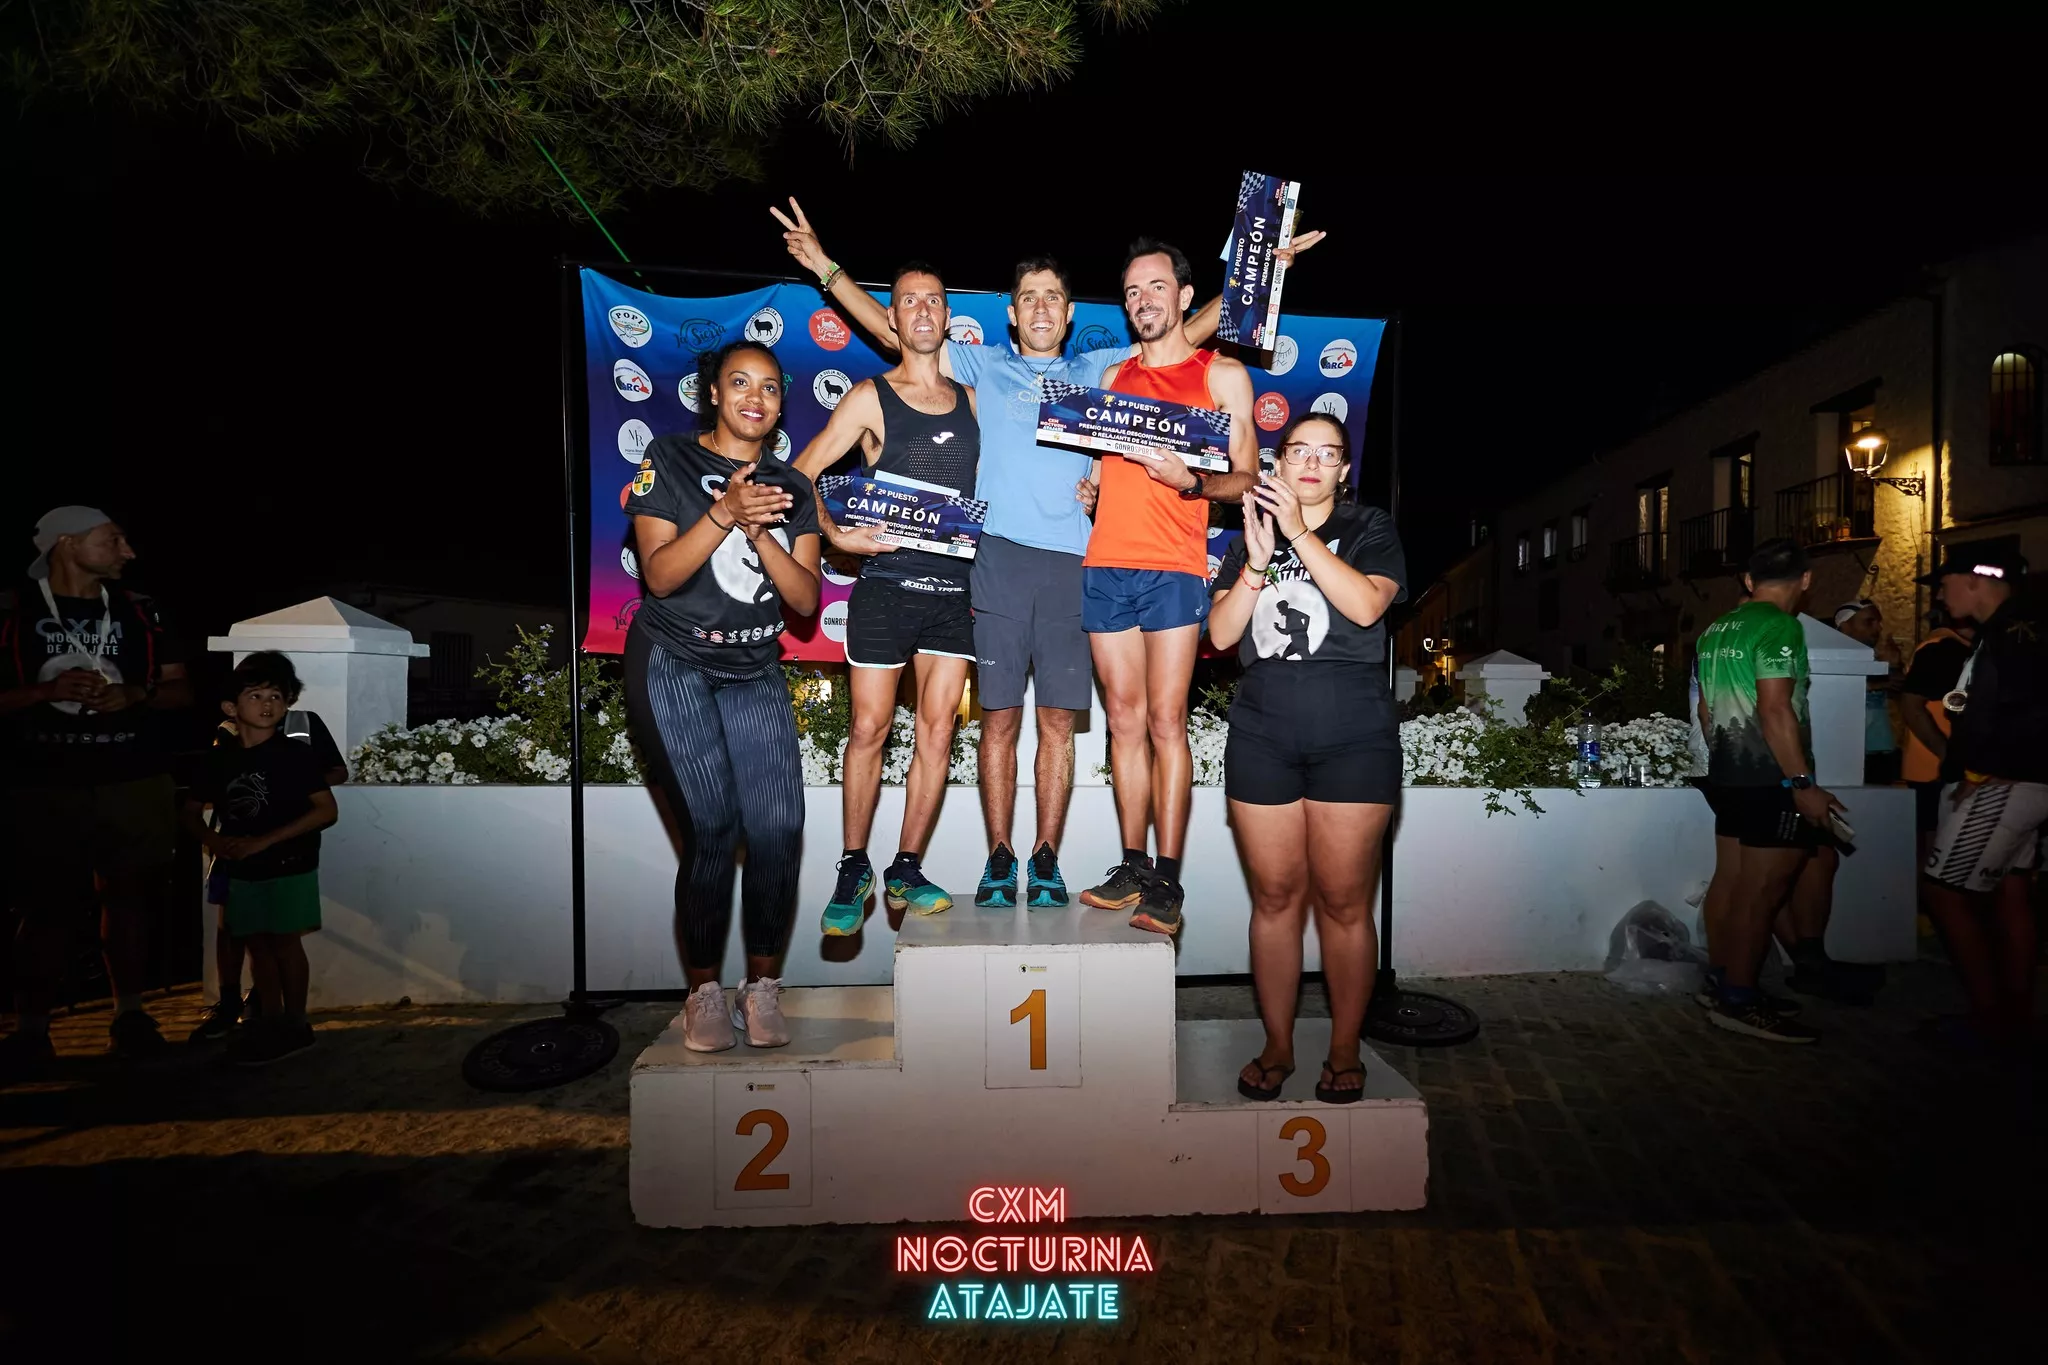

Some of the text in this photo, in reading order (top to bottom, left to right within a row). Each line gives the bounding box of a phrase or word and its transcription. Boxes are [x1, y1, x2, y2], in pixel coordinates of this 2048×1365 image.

[1235, 238, 1245, 267] PUESTO
[1241, 216, 1266, 306] CAMPEÓN
[1261, 262, 1270, 287] PREMIO
[615, 311, 644, 325] POPI
[1323, 361, 1344, 370] ARC
[1129, 400, 1161, 414] PUESTO
[1086, 407, 1186, 436] CAMPEÓN
[1078, 423, 1191, 447] PREMIO MASAJE DESCONTRACTURANTE
[1097, 432, 1131, 442] RELAJANTE
[1148, 440, 1177, 451] MINUTOS.
[877, 488, 919, 503] 2º PUESTO
[845, 513, 865, 521] PREMIO
[847, 497, 941, 525] CAMPEÓN
[46, 644, 63, 654] DE
[1010, 989, 1047, 1070] 1
[734, 1108, 790, 1192] 2
[1278, 1115, 1331, 1198] 3
